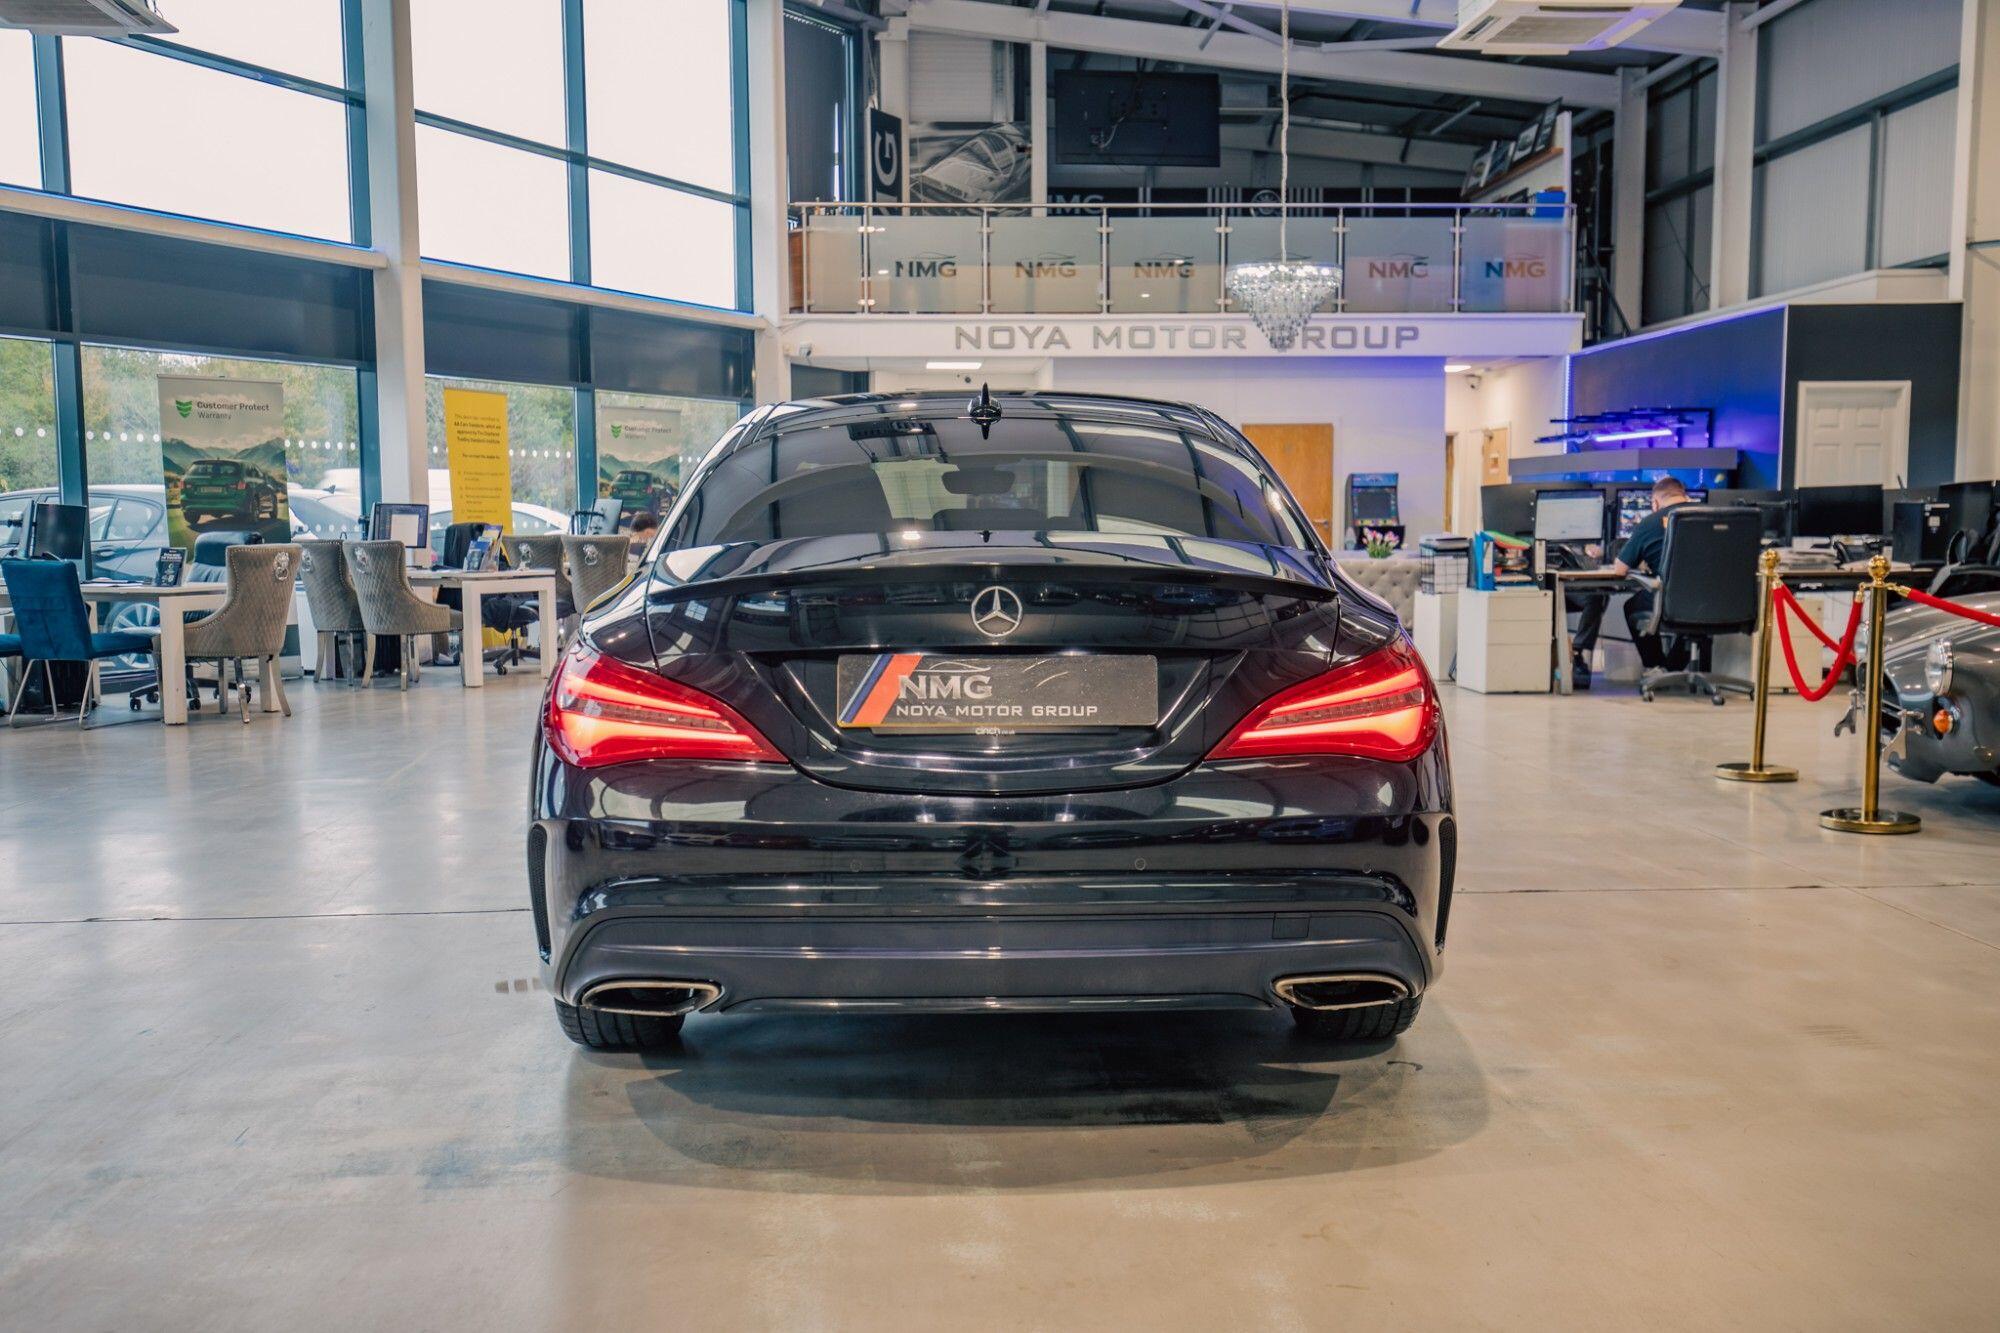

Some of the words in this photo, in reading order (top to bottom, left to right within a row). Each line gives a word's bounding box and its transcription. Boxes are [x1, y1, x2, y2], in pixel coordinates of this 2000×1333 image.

[895, 260, 957, 278] NMG
[1015, 261, 1077, 278] NMG
[1134, 261, 1195, 278] NMG
[1485, 261, 1546, 278] NMG
[954, 325, 1071, 350] NOYA
[1092, 325, 1248, 350] MOTOR
[196, 401, 238, 410] Customer
[239, 402, 270, 411] Protect
[898, 675, 993, 700] NMG
[896, 704, 947, 717] NOYA
[955, 704, 1023, 717] MOTOR
[1032, 704, 1098, 717] GROUP
